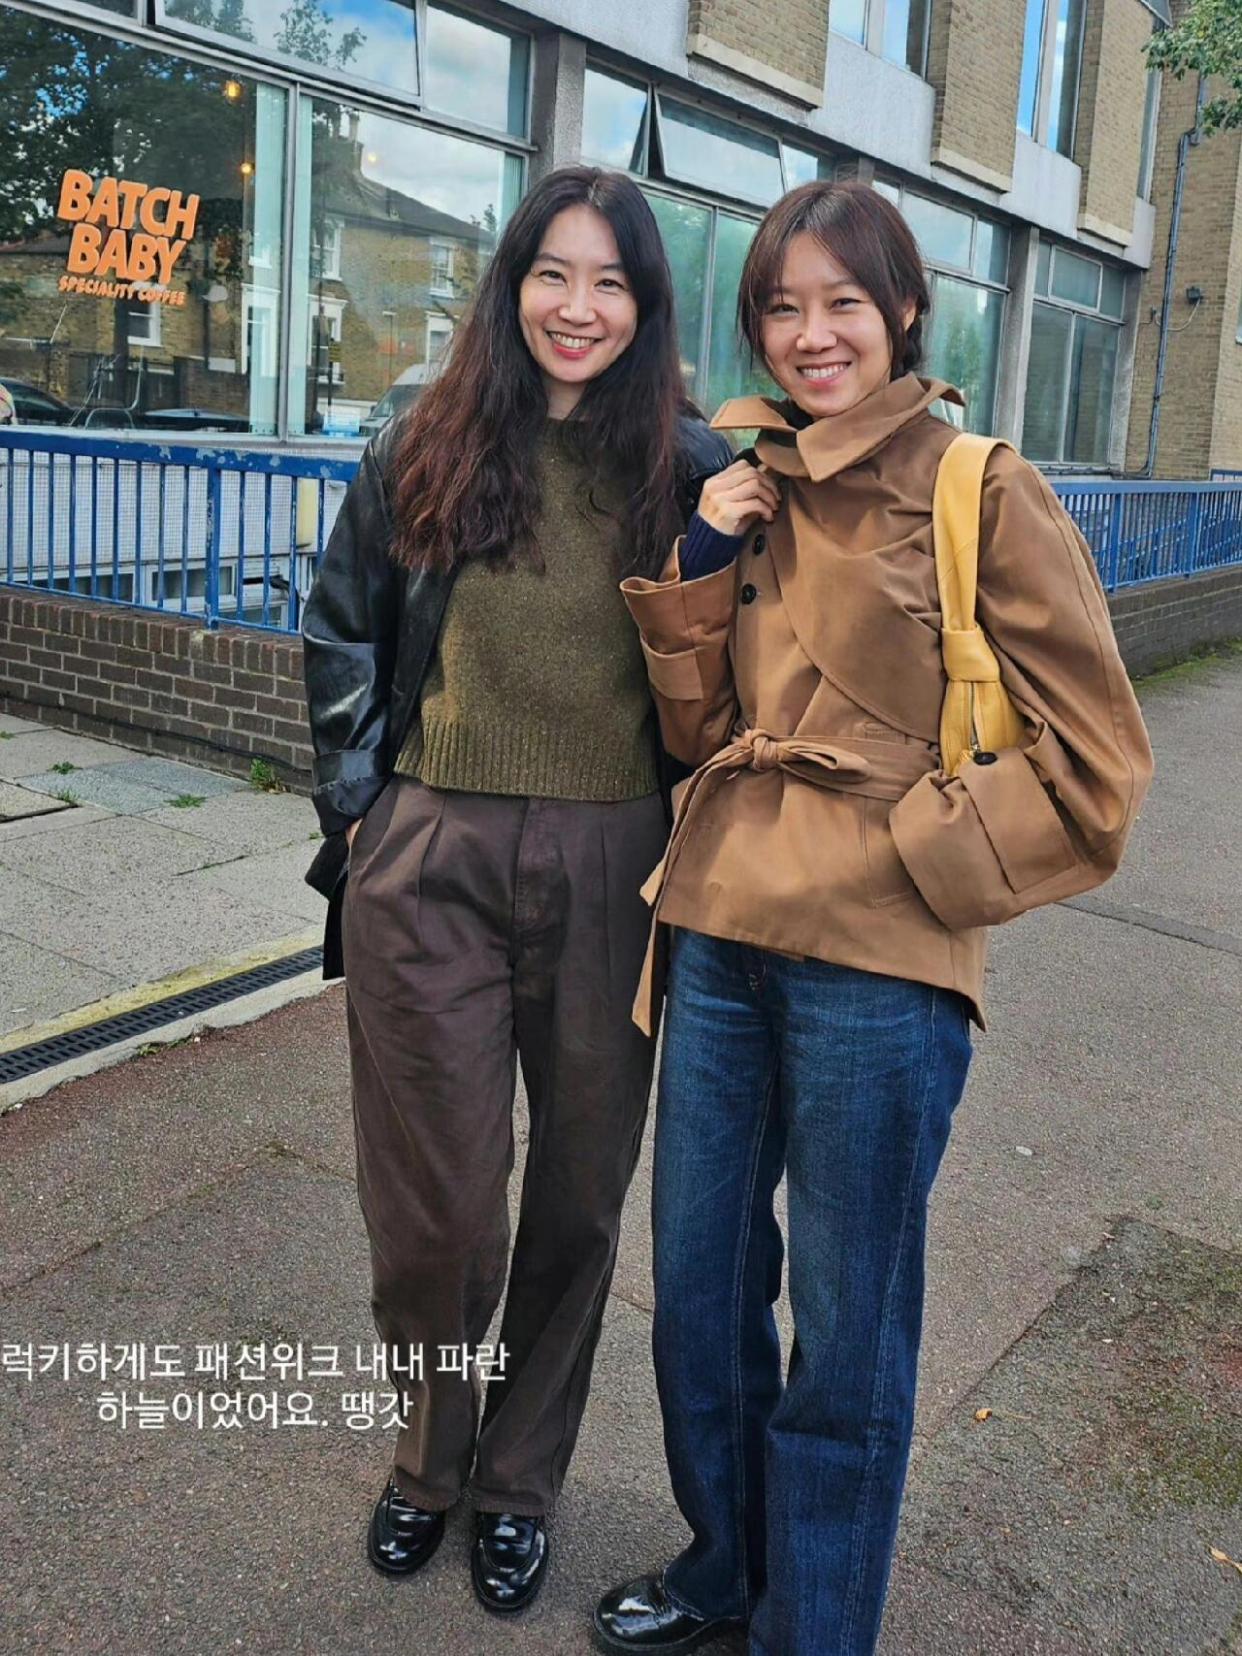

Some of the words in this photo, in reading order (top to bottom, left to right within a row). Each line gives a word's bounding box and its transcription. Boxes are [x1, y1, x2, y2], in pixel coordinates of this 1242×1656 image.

[57, 169, 200, 240] BATCH
[67, 223, 186, 284] BABY
[59, 276, 135, 299] SPECIALITY
[138, 287, 186, 305] COFFEE
